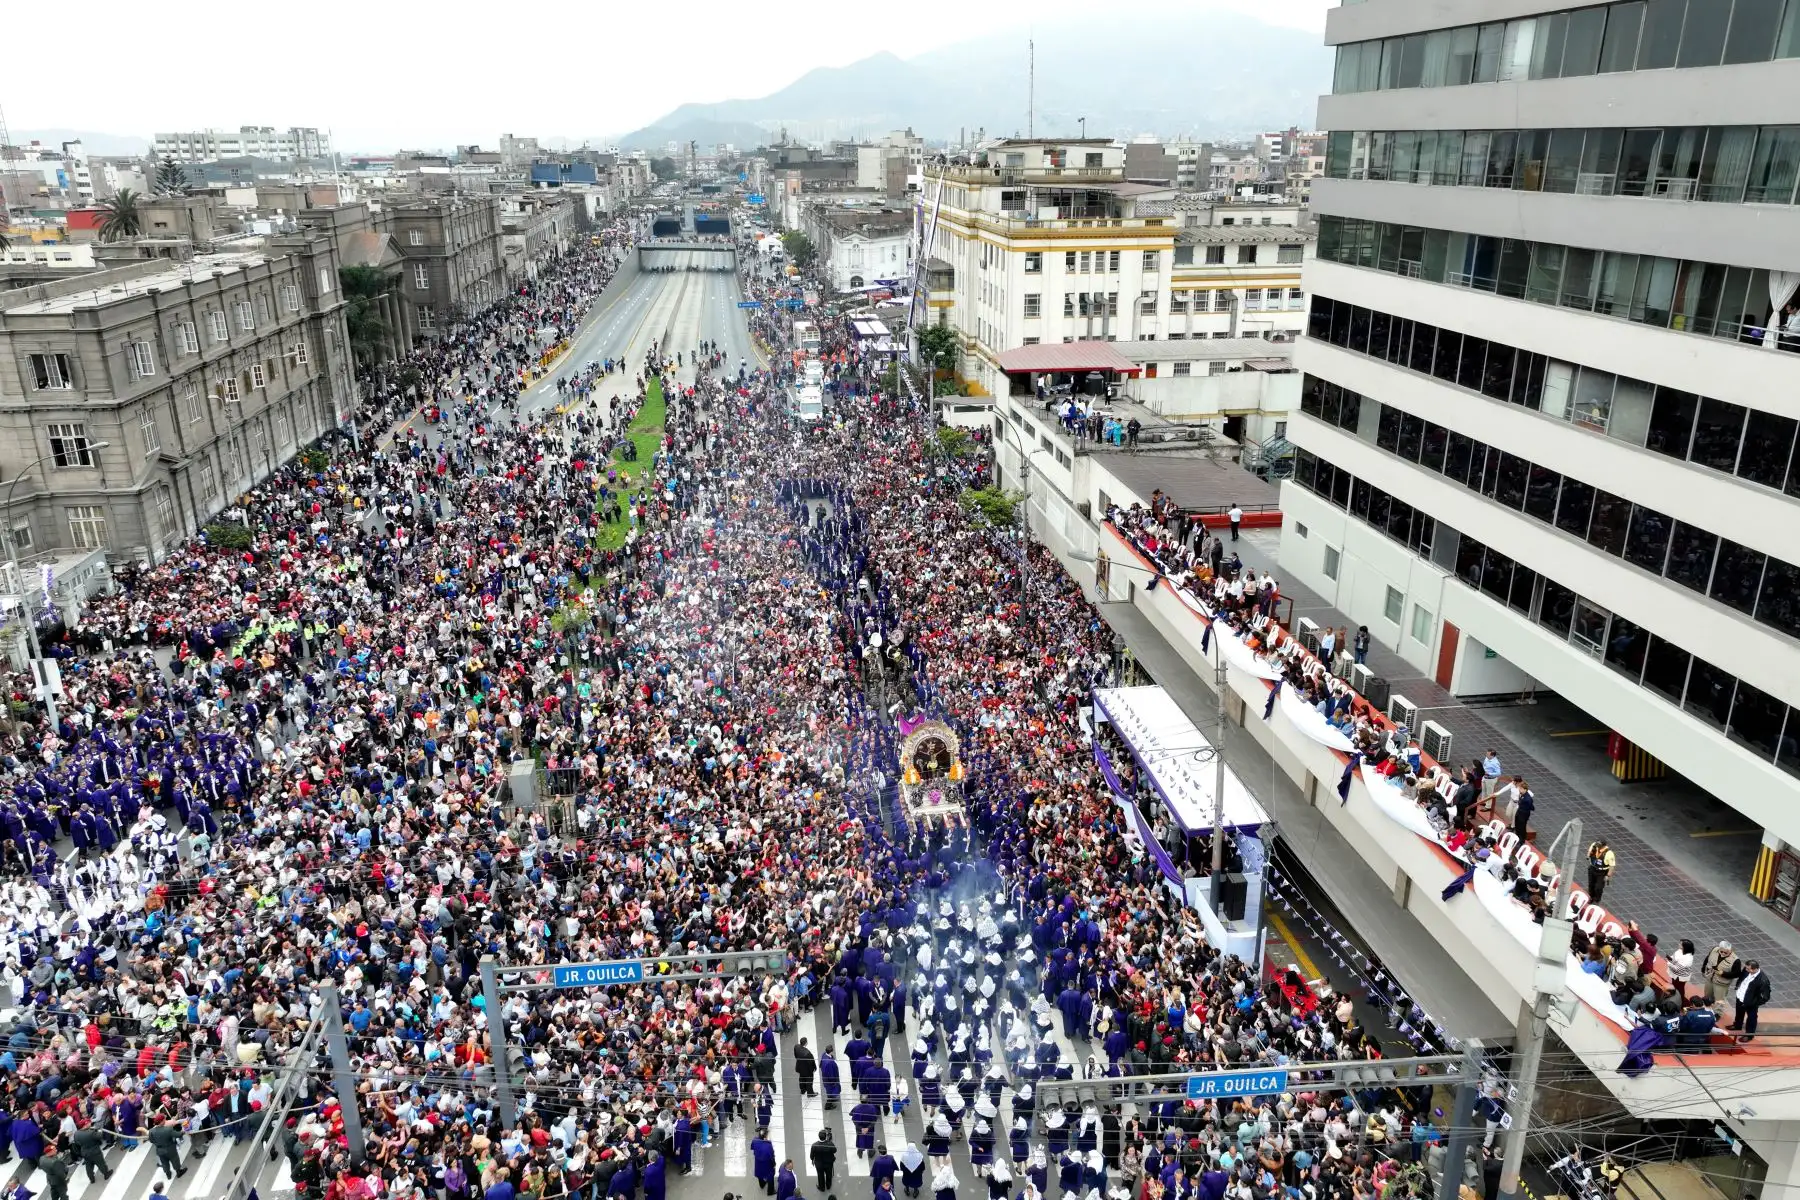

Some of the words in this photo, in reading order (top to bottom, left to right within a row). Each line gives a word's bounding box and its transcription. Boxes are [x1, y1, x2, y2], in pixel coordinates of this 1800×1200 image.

[562, 970, 584, 983] JR.
[586, 966, 636, 981] QUILCA
[1196, 1080, 1220, 1094] JR.
[1224, 1076, 1278, 1092] QUILCA
